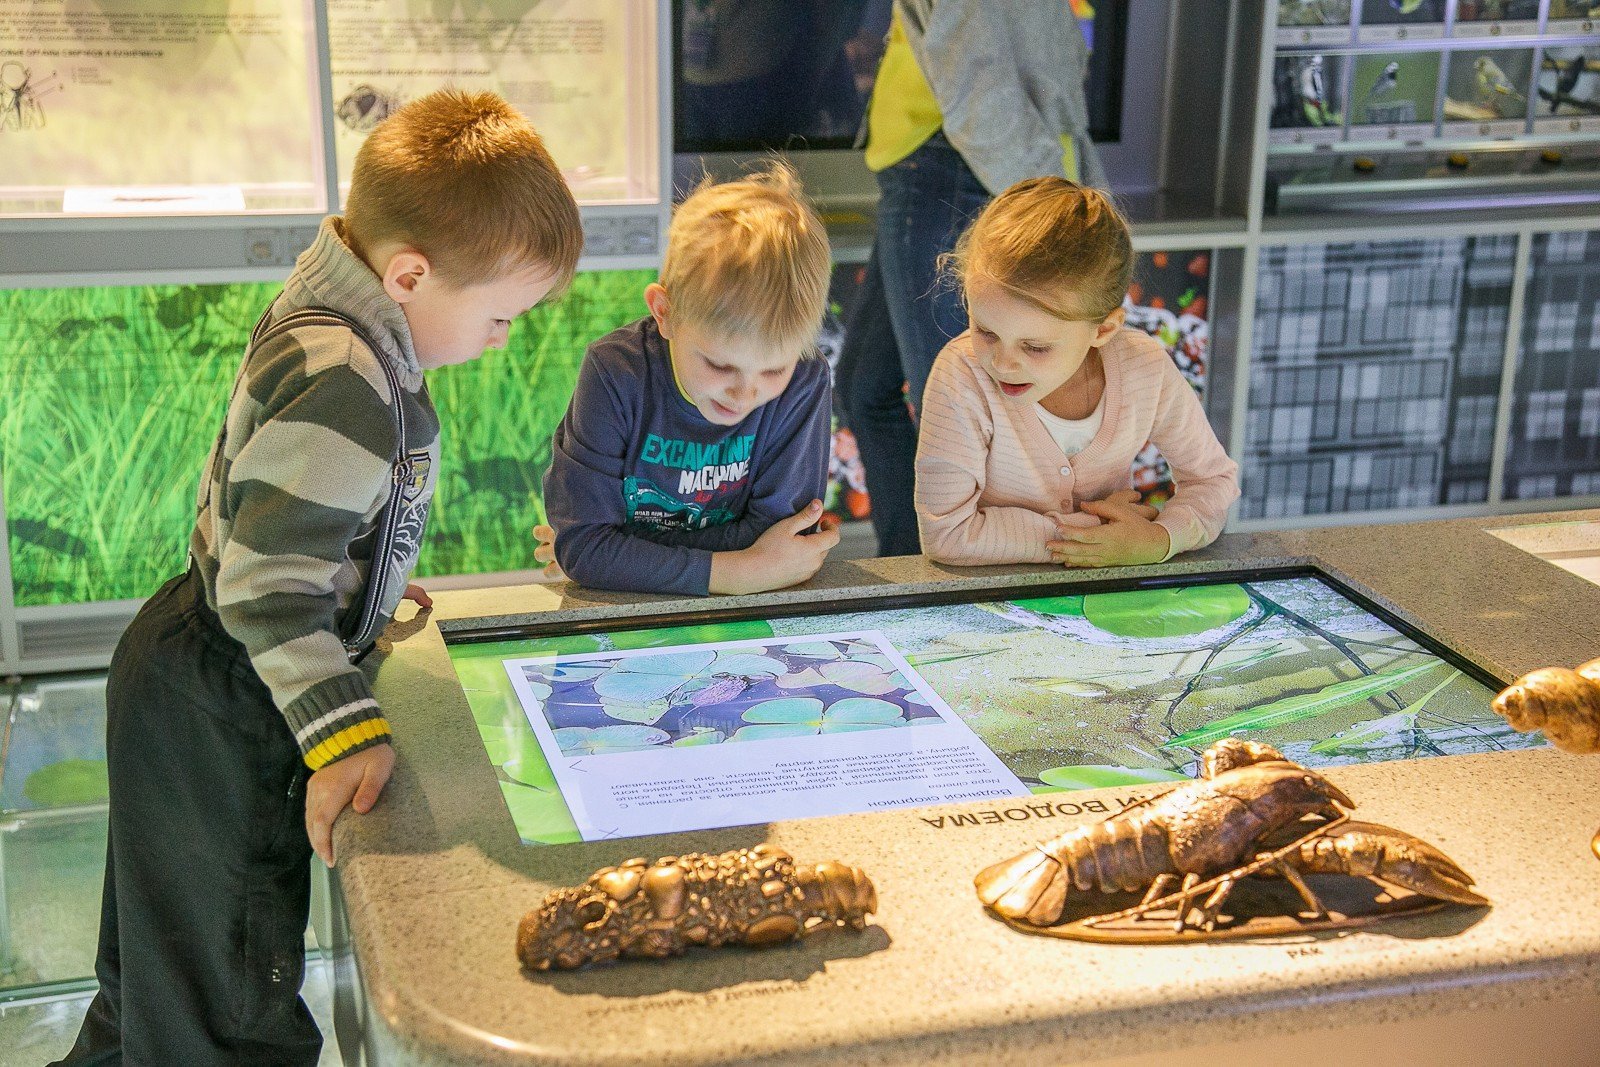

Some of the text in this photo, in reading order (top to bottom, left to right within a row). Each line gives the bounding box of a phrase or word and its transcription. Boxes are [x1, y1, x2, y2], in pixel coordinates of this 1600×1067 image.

[868, 789, 1012, 807] Водяной скорпион
[922, 799, 1109, 829] ВОДОЕМА
